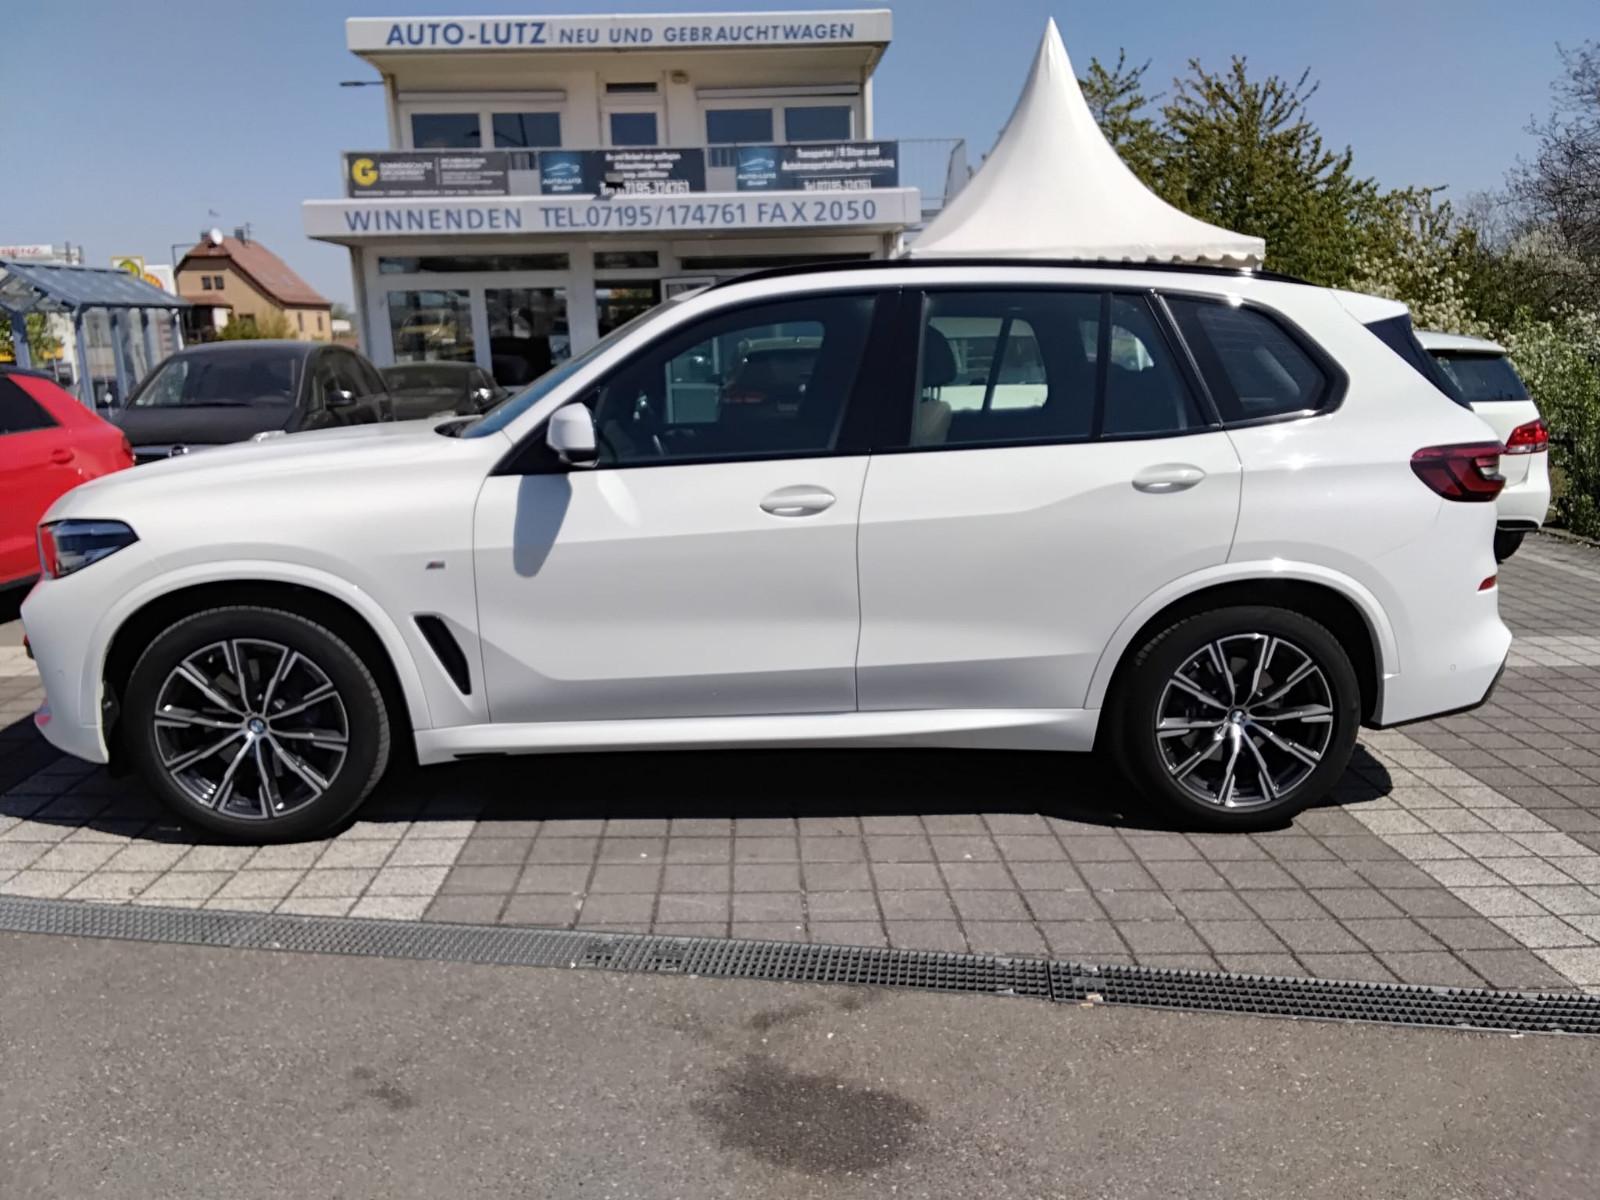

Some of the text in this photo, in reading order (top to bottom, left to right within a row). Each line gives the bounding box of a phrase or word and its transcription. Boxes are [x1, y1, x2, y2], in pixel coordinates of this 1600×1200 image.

[386, 23, 855, 45] AUTO-LUTZ NEU UND GEBRAUCHTWAGEN
[345, 207, 522, 232] WINNENDEN
[757, 202, 808, 223] FAX
[814, 199, 876, 222] 2050
